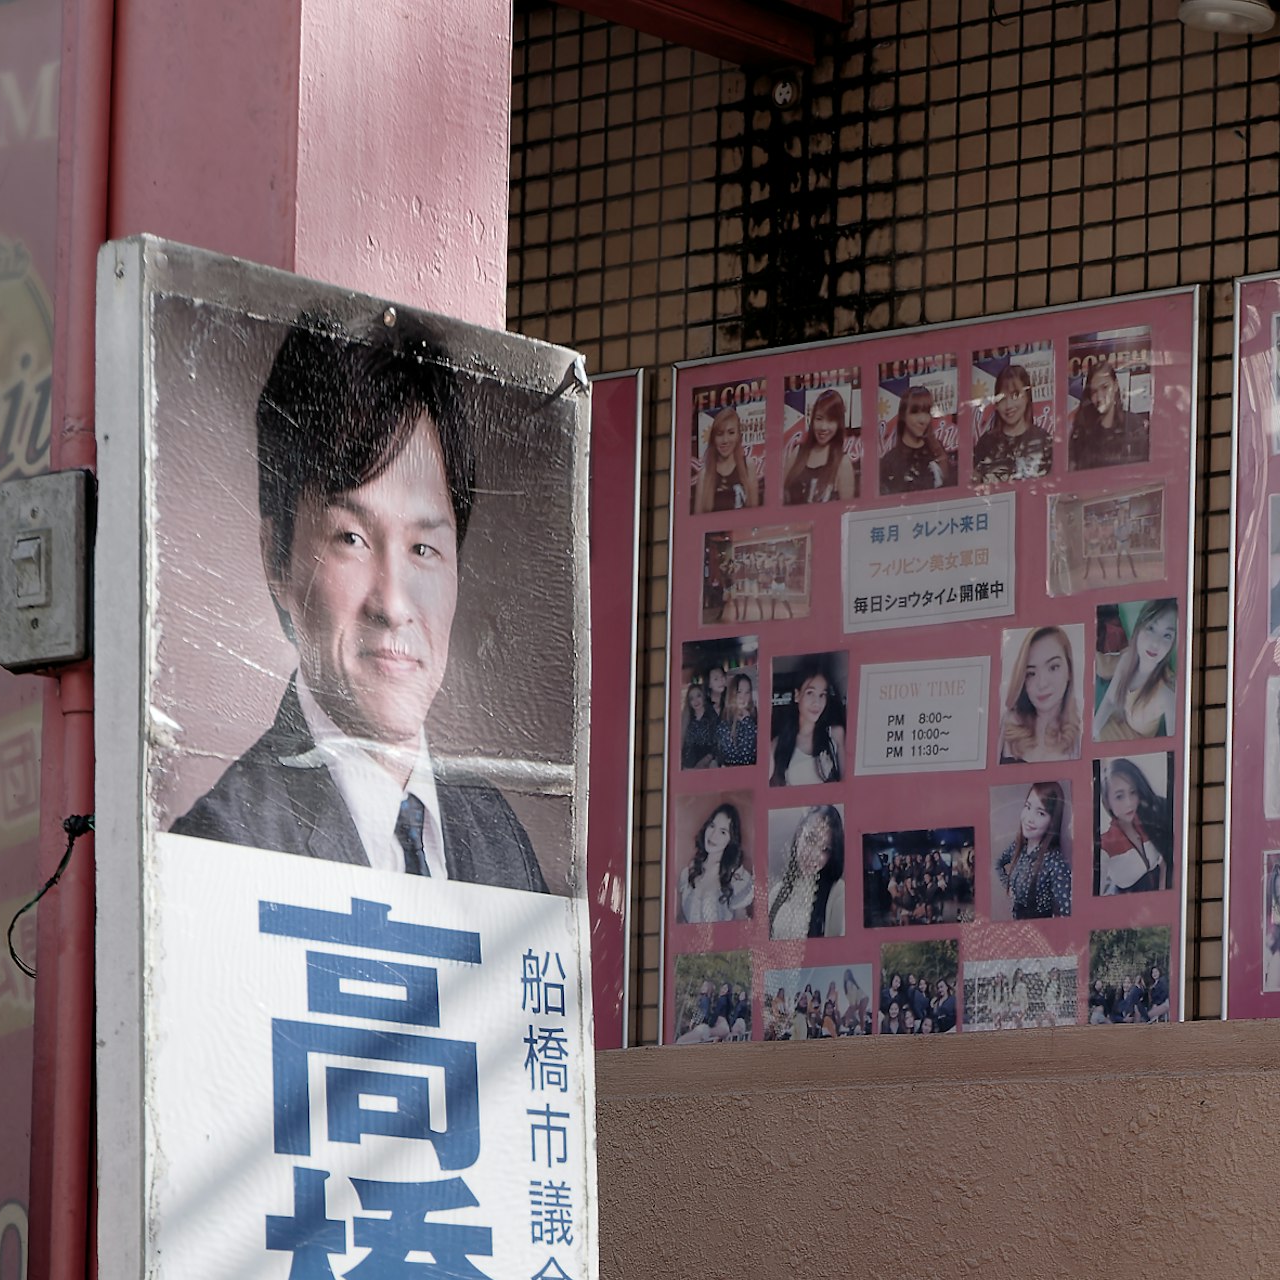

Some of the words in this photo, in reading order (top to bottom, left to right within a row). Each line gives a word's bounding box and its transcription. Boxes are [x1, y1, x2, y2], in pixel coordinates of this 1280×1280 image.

[870, 525, 899, 543] 毎月
[913, 513, 988, 540] タレント来日
[854, 580, 1004, 614] 毎日ショウタイム開催中
[879, 682, 921, 700] SHOW
[927, 680, 966, 697] TIME
[887, 714, 904, 726] PM
[886, 730, 903, 742] PM
[885, 746, 902, 758] PM
